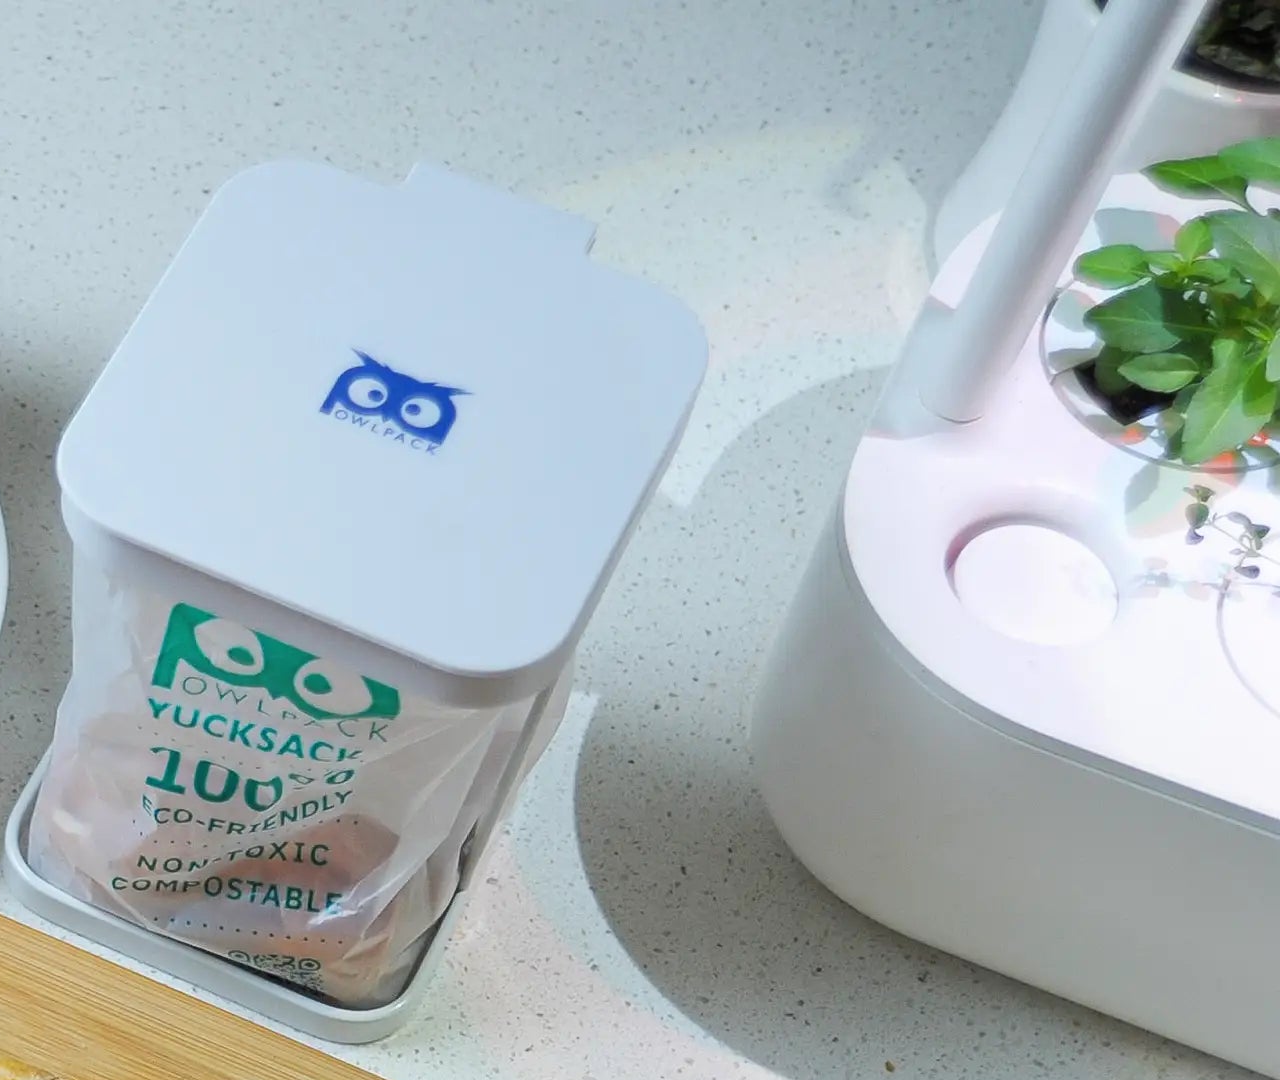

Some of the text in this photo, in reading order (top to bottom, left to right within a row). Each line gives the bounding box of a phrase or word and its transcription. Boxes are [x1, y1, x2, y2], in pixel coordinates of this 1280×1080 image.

[333, 408, 441, 456] OWLPACK
[141, 790, 354, 836] ECO-FRIENDLY
[136, 841, 330, 873] NON-TOXIC
[111, 875, 344, 914] COMPOSTABLE
